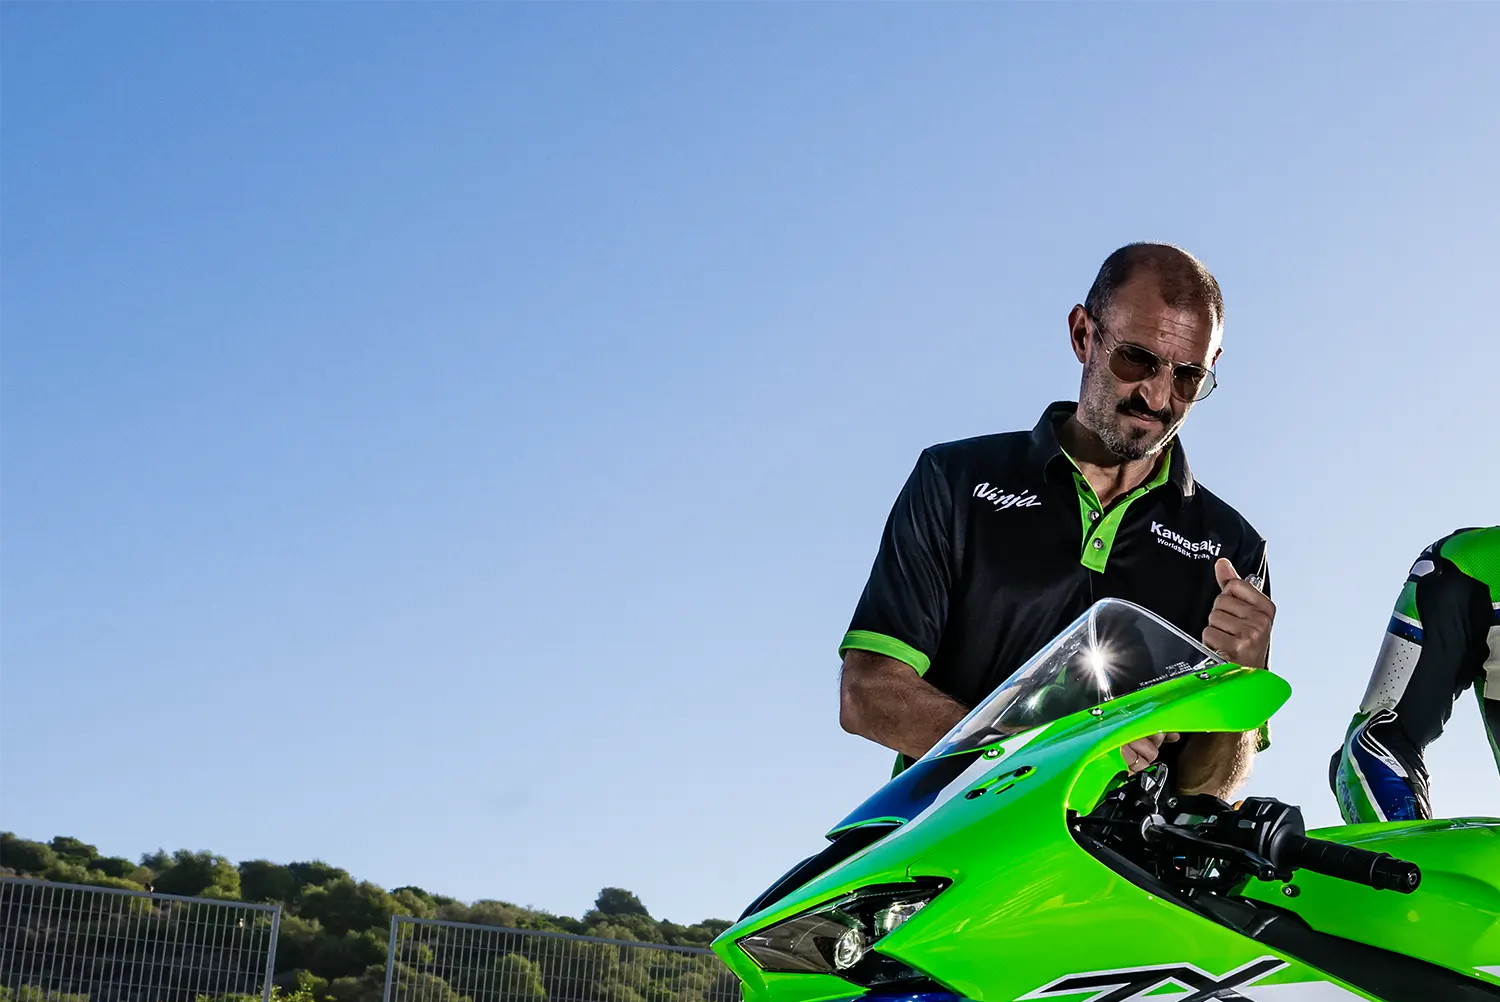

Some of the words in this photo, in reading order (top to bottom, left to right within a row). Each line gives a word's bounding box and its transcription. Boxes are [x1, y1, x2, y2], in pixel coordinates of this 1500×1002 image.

[973, 482, 1042, 512] Ninja
[1150, 520, 1222, 556] Kawasaki
[1157, 537, 1191, 558] WorldSBK
